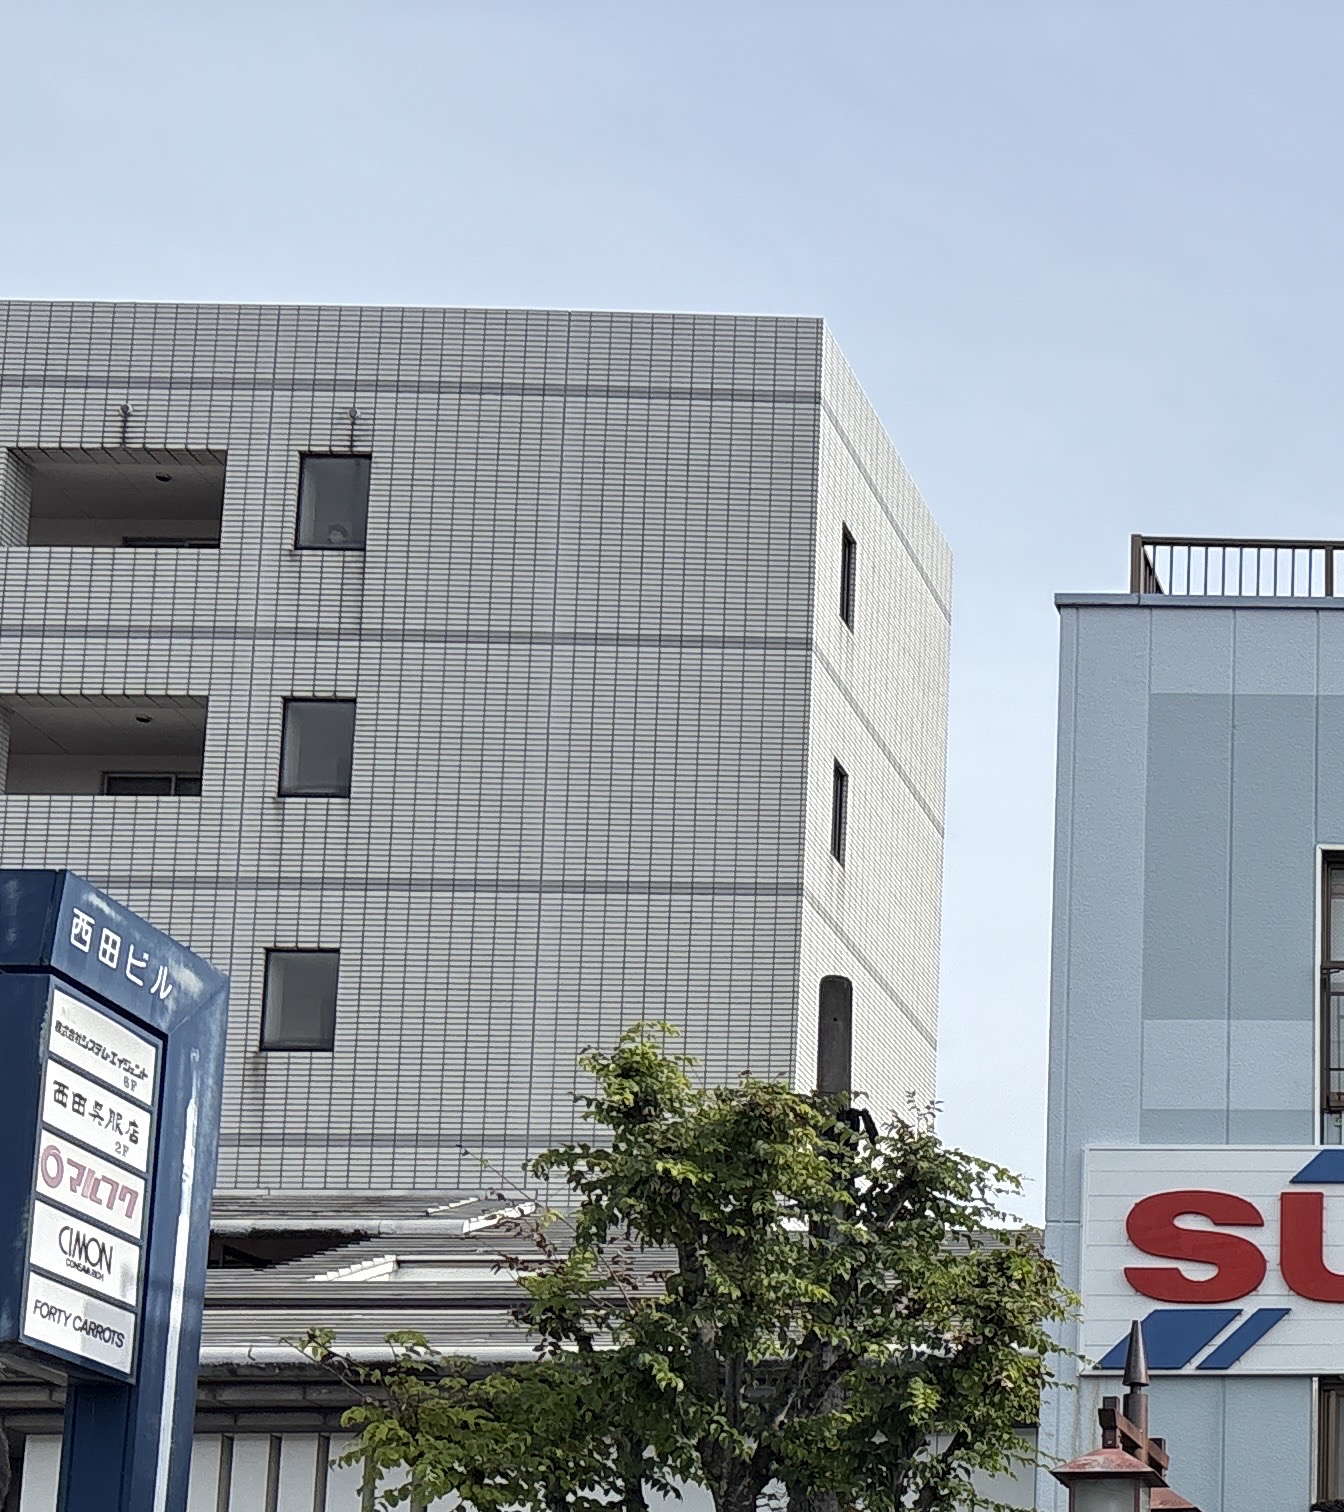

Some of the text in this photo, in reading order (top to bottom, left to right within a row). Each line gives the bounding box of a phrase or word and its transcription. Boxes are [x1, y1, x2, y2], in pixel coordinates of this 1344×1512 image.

[70, 907, 173, 1001] 西田ビル
[52, 1080, 140, 1145] 西田呉服店
[58, 1225, 114, 1276] CIMON
[33, 1299, 125, 1349] FORTY CARROTS
